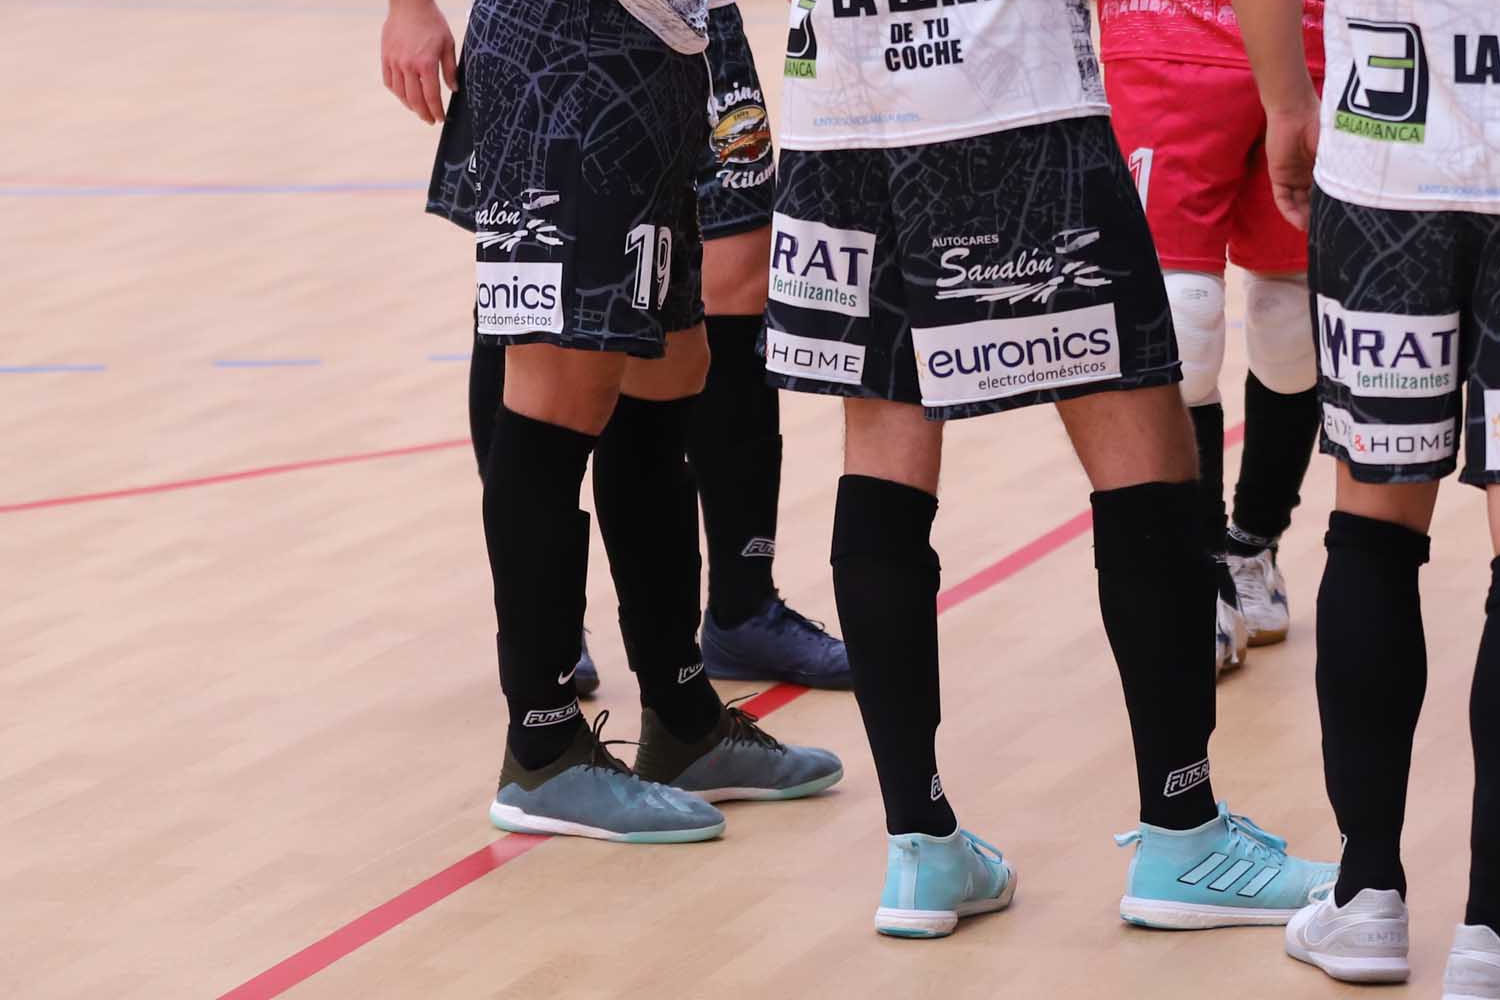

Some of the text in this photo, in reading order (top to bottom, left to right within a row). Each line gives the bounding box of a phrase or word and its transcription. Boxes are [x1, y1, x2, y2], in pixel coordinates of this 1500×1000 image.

[890, 18, 949, 44] DE TU
[884, 39, 964, 72] COCHE
[1334, 113, 1421, 142] SALAMANCA
[932, 234, 999, 248] AUTOCARES
[625, 223, 673, 311] 19
[772, 231, 869, 287] RAT
[936, 247, 1054, 288] Sanalón
[773, 275, 857, 308] fertilizantes
[771, 343, 860, 373] HOME
[928, 327, 1111, 378] euronics
[978, 361, 1107, 390] electrodomésticos
[1357, 371, 1449, 390] fertilizantes
